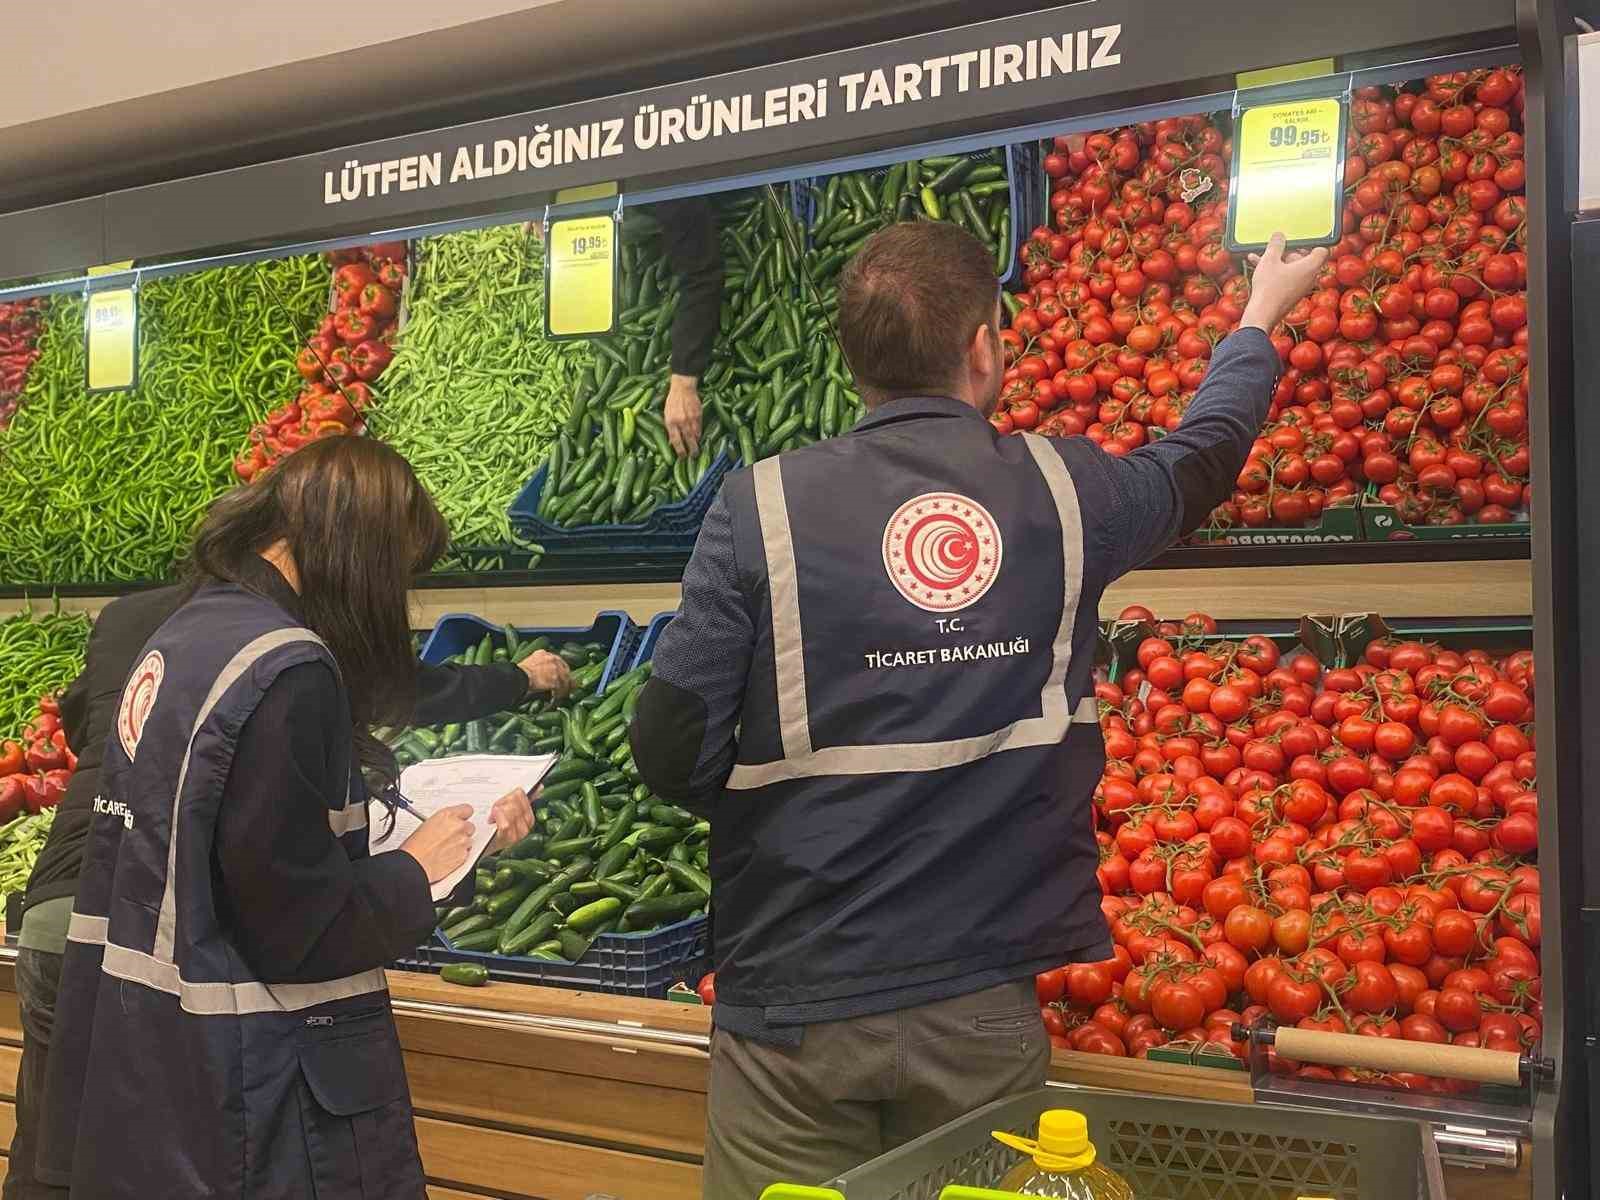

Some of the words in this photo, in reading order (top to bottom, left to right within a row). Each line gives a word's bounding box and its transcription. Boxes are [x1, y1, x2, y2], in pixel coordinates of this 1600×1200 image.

[324, 152, 442, 204] LÜTFEN
[449, 118, 624, 183] ALDIĞINIZ
[633, 78, 827, 150] ÜRÜNLERİ
[839, 23, 1121, 112] TARTTIRINIZ
[936, 618, 964, 634] T.C.
[865, 649, 936, 668] TİCARET
[940, 637, 1030, 663] BAKANLIĞI
